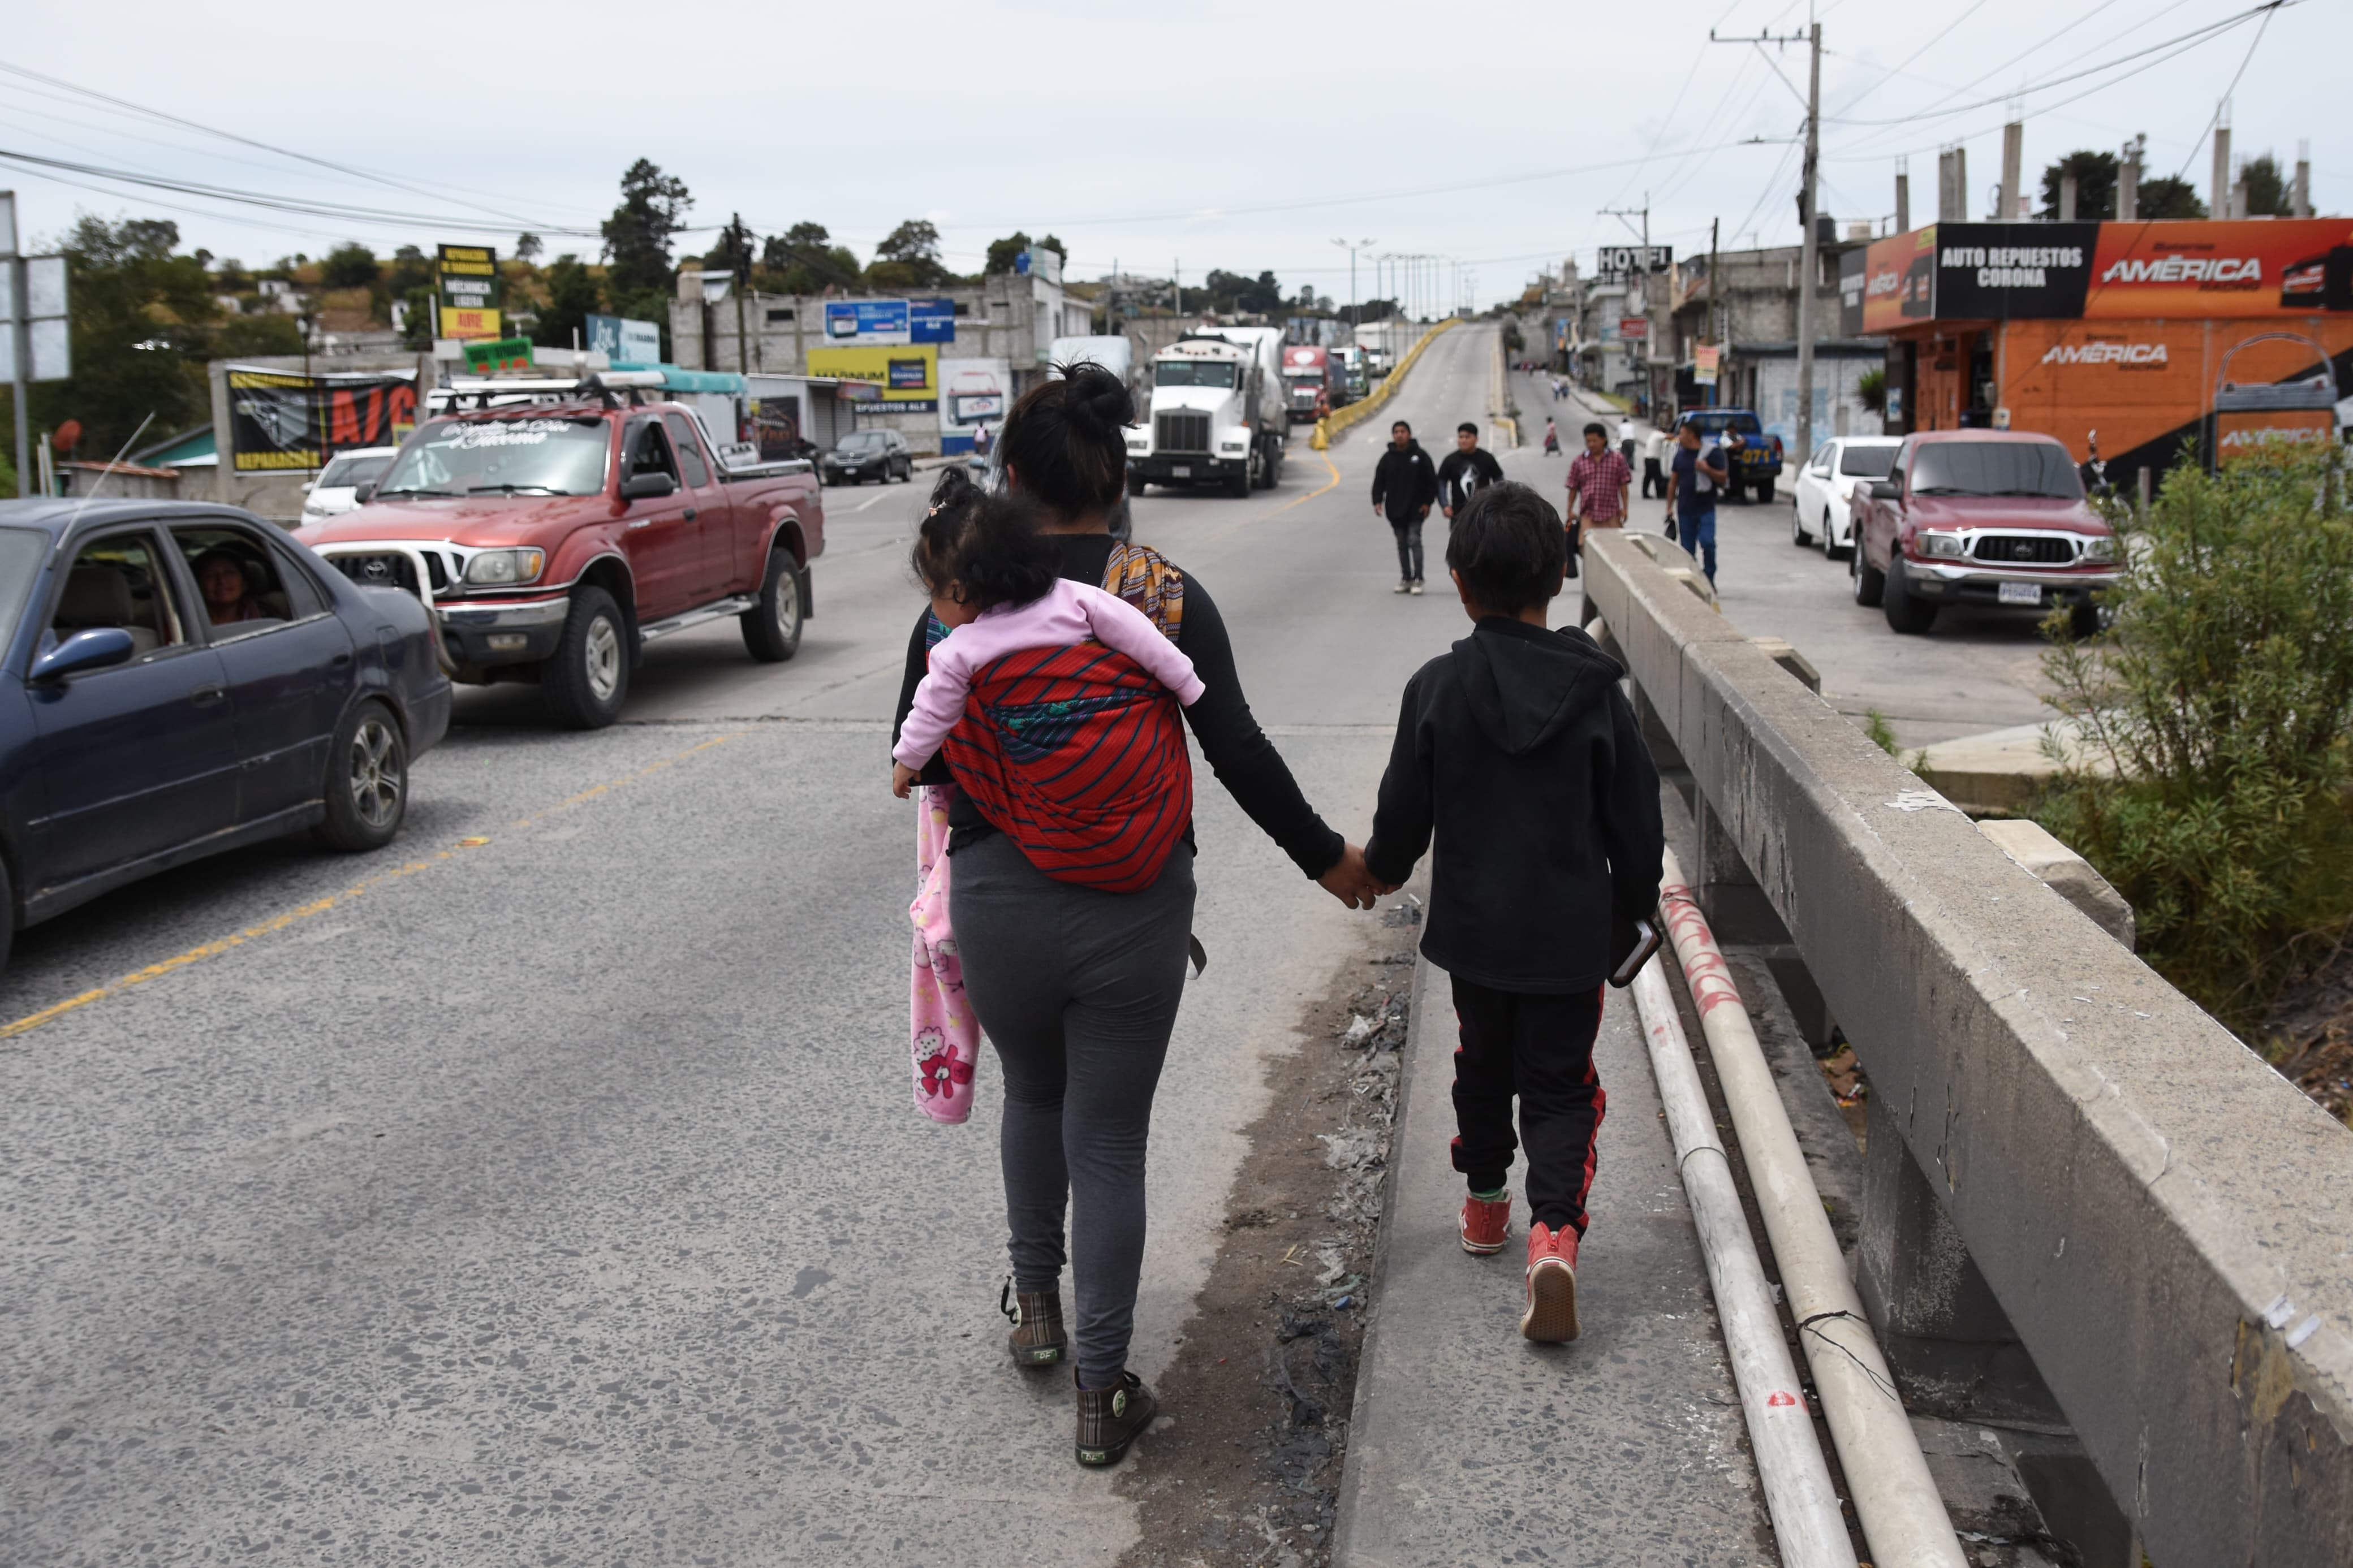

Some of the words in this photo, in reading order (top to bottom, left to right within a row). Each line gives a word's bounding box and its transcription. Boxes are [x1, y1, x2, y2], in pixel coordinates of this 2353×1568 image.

[1941, 247, 1986, 267] AUTO
[1989, 247, 2083, 267] REPUESTOS
[1977, 267, 2046, 287] CORONA
[2102, 254, 2261, 283] AMÉRICA
[2041, 340, 2168, 364] AMÉRICA
[331, 386, 416, 444] A/C
[908, 401, 928, 411] ALE
[1742, 448, 1770, 464] 071
